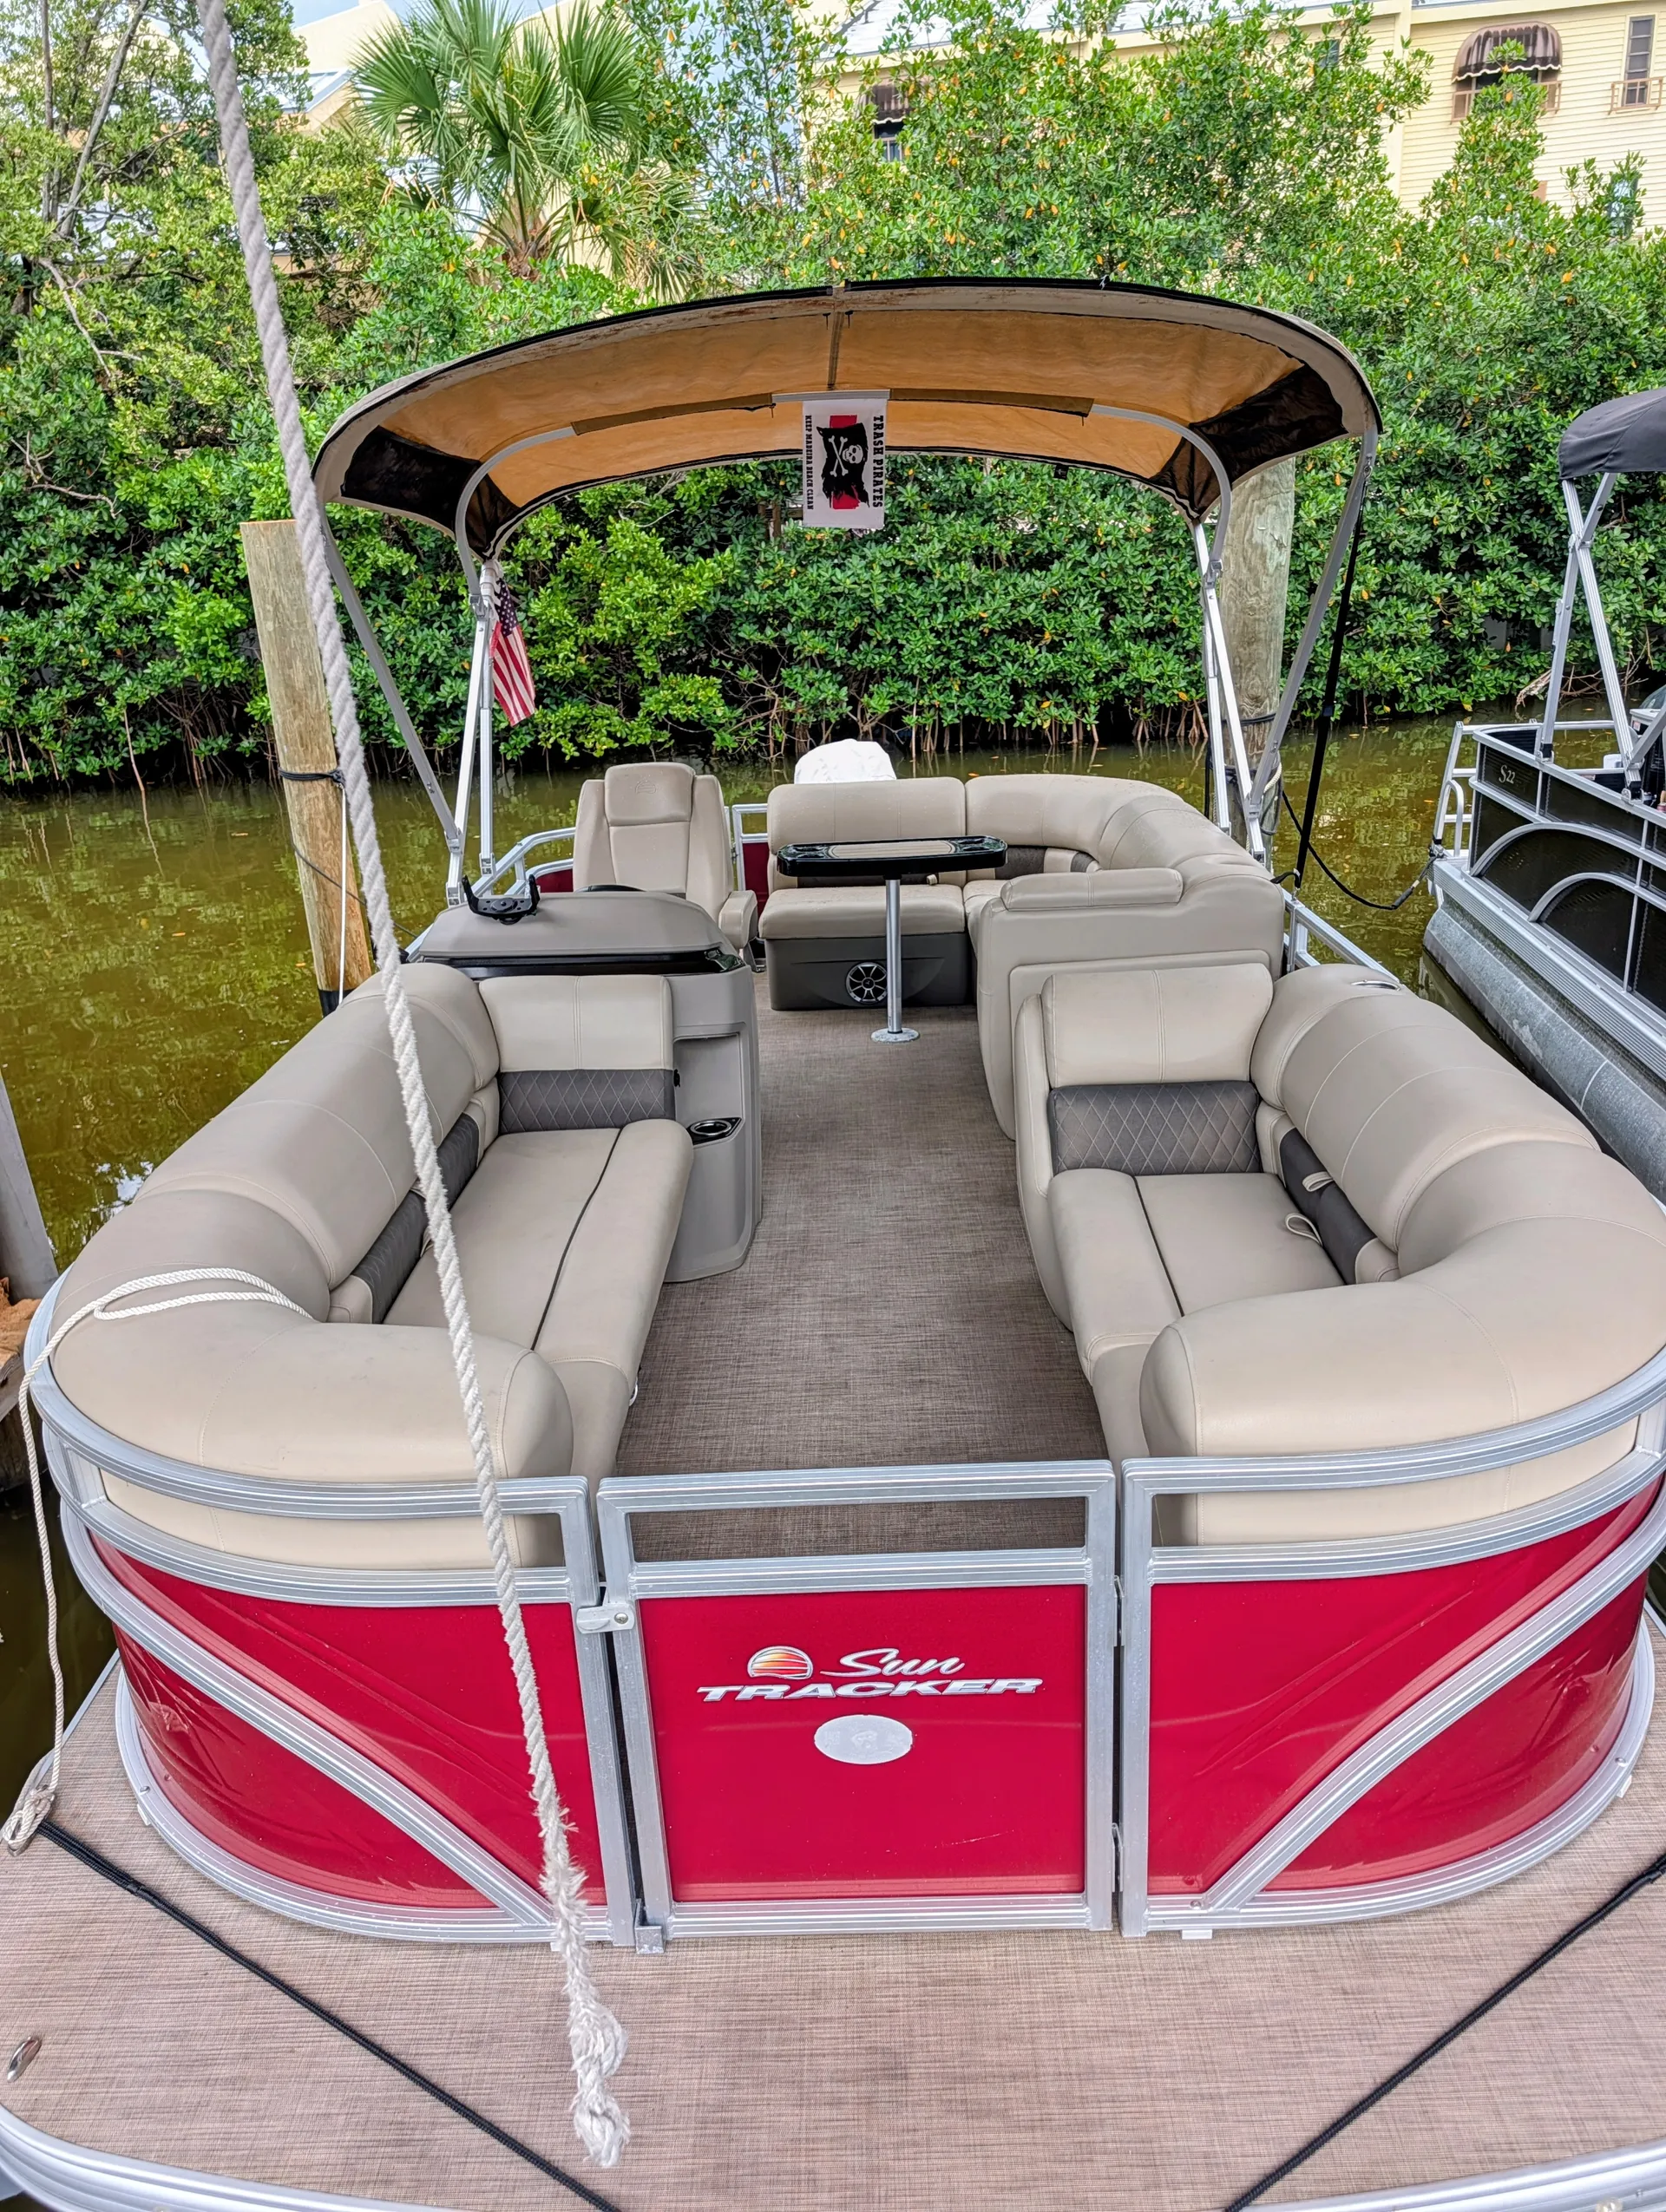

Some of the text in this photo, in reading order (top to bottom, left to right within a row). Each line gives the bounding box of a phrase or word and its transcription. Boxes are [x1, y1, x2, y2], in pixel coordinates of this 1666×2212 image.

[873, 416, 884, 507] TRASH PIRATES
[1498, 764, 1516, 784] S22
[820, 1647, 965, 1677] Sun
[697, 1678, 1043, 1702] TRACKER
